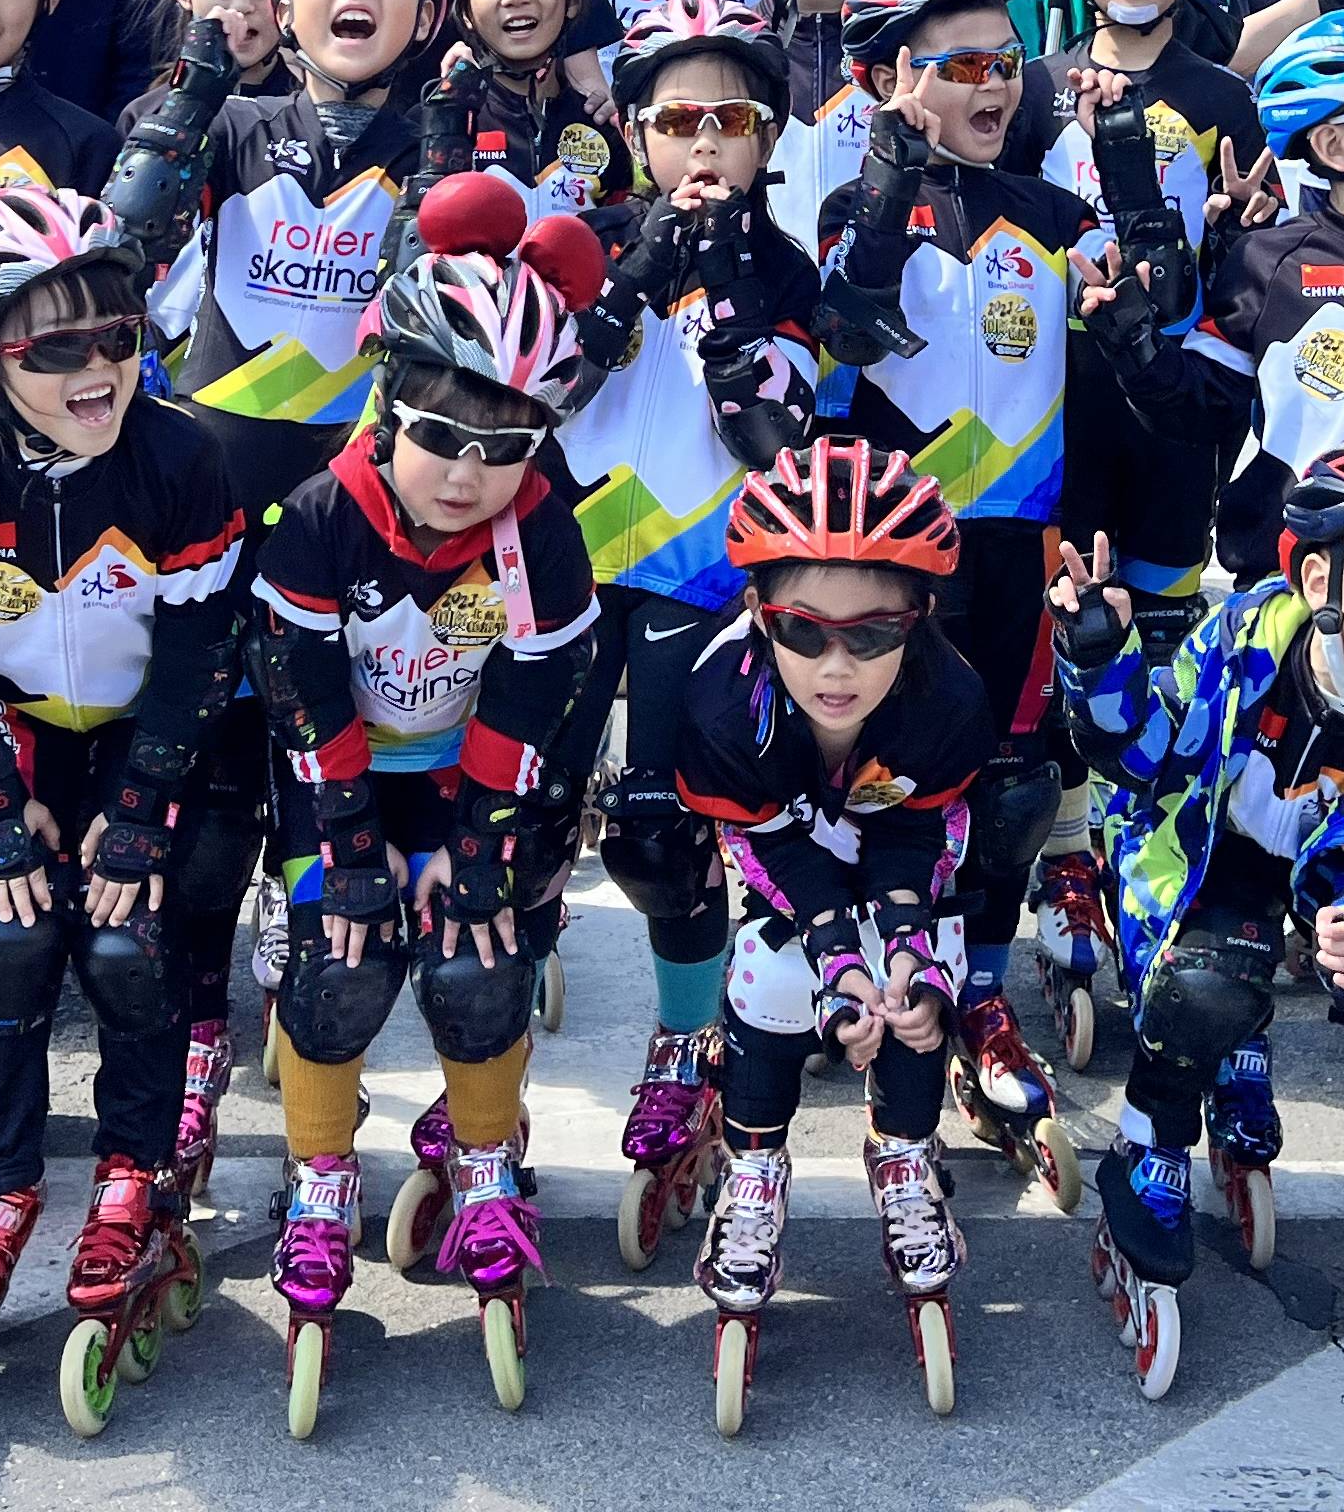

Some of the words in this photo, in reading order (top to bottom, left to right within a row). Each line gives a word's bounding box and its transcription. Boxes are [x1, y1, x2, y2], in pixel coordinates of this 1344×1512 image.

[837, 139, 869, 149] BingS
[472, 150, 507, 160] CHINA
[270, 219, 375, 257] roller
